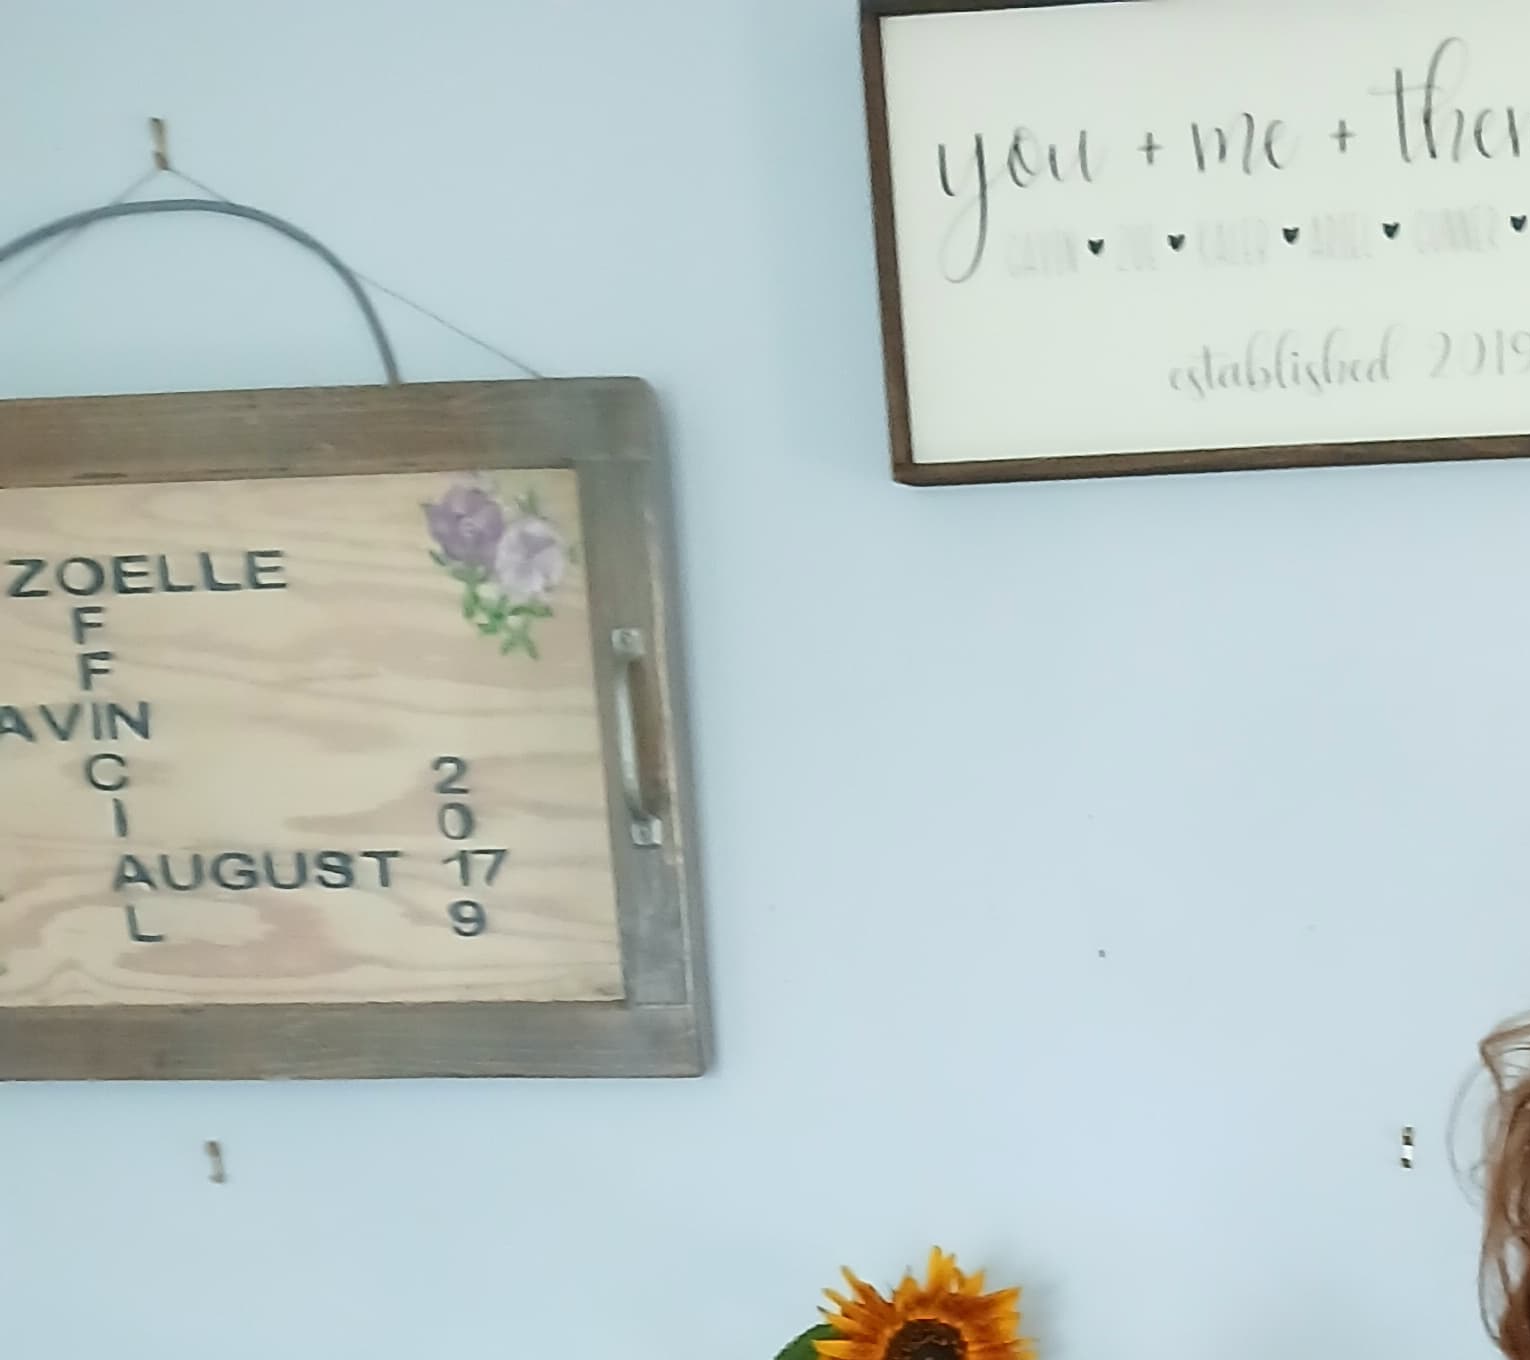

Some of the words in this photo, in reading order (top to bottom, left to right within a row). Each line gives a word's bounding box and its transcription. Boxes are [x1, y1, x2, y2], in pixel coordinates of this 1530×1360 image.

[937, 127, 1095, 283] you
[1136, 131, 1163, 166] +
[1190, 112, 1288, 176] me
[1330, 118, 1358, 153] +
[1168, 323, 1404, 399] established
[4, 550, 288, 598] ZOELLE
[113, 850, 403, 892] AUGUST
[443, 848, 509, 887] 17
